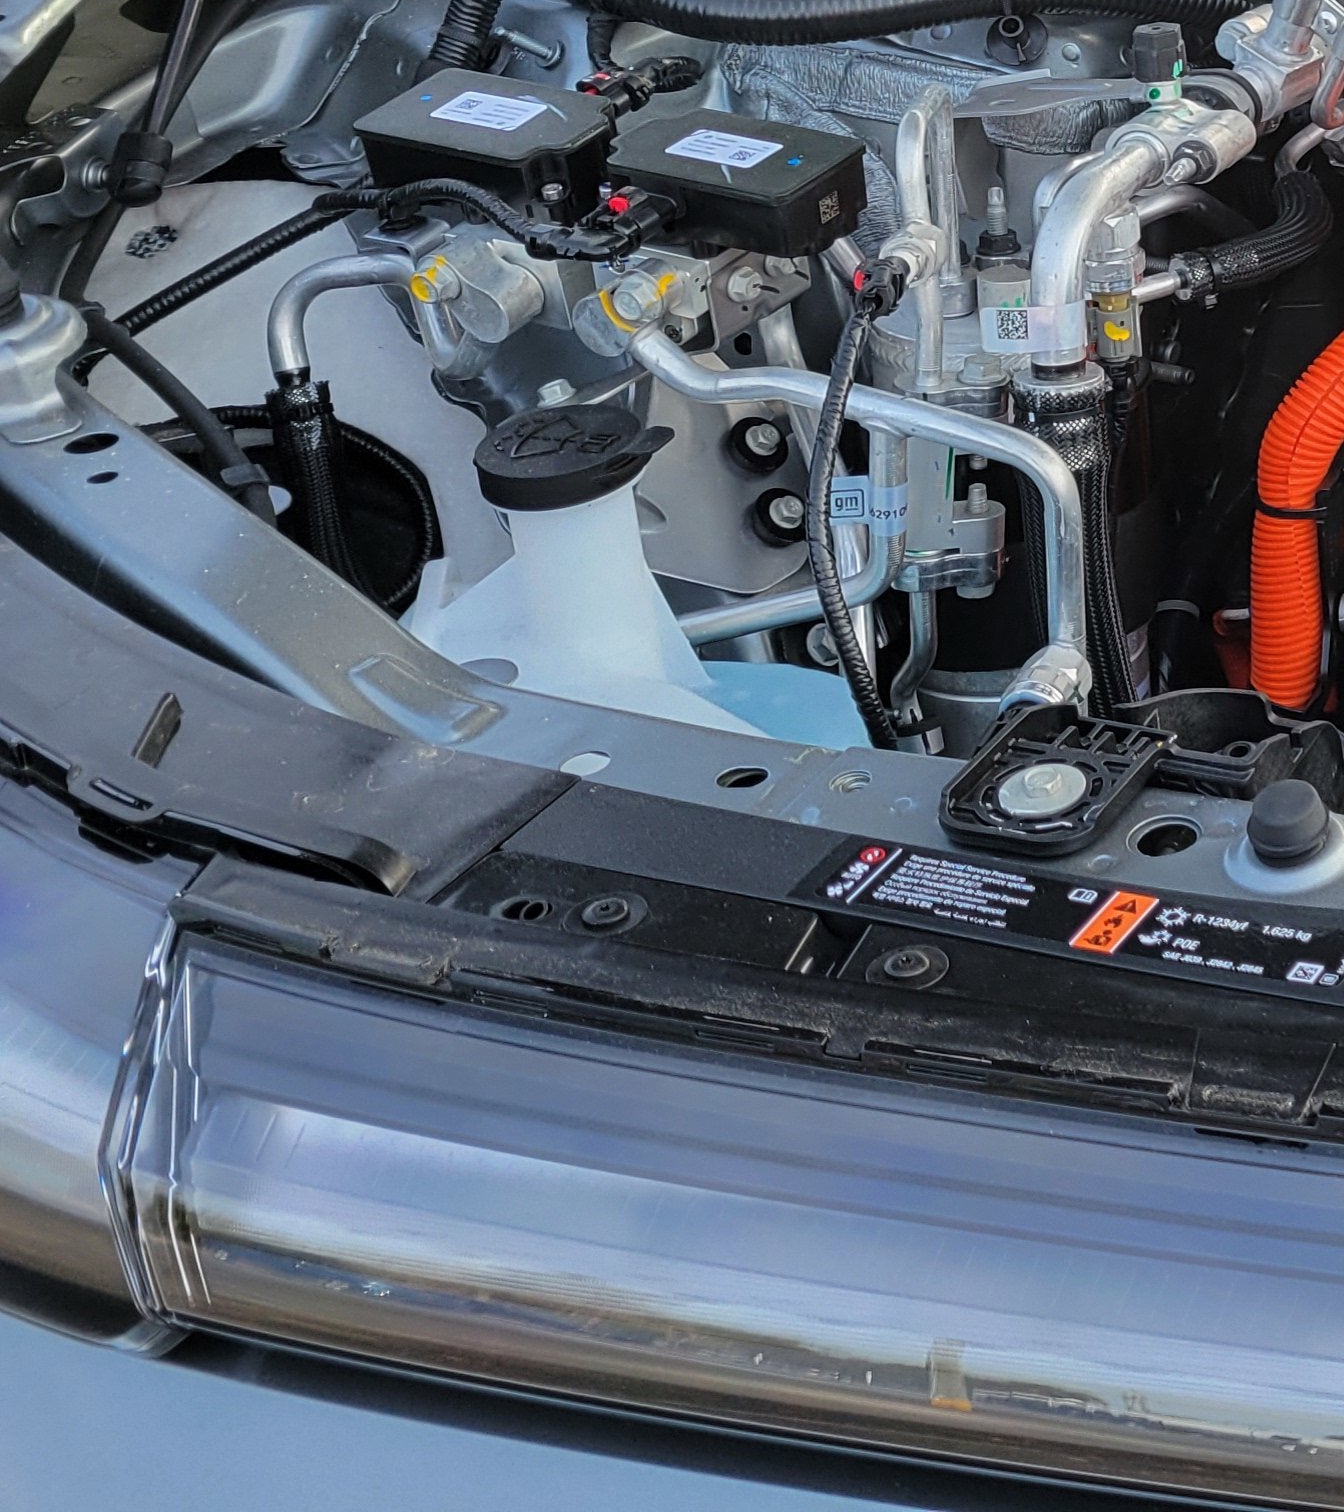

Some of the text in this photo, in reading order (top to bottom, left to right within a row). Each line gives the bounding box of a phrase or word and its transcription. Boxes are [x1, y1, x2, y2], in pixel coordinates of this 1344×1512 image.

[835, 496, 859, 512] gm
[1192, 913, 1313, 943] R-1234yf 1.625 kg
[1172, 938, 1201, 951] POE
